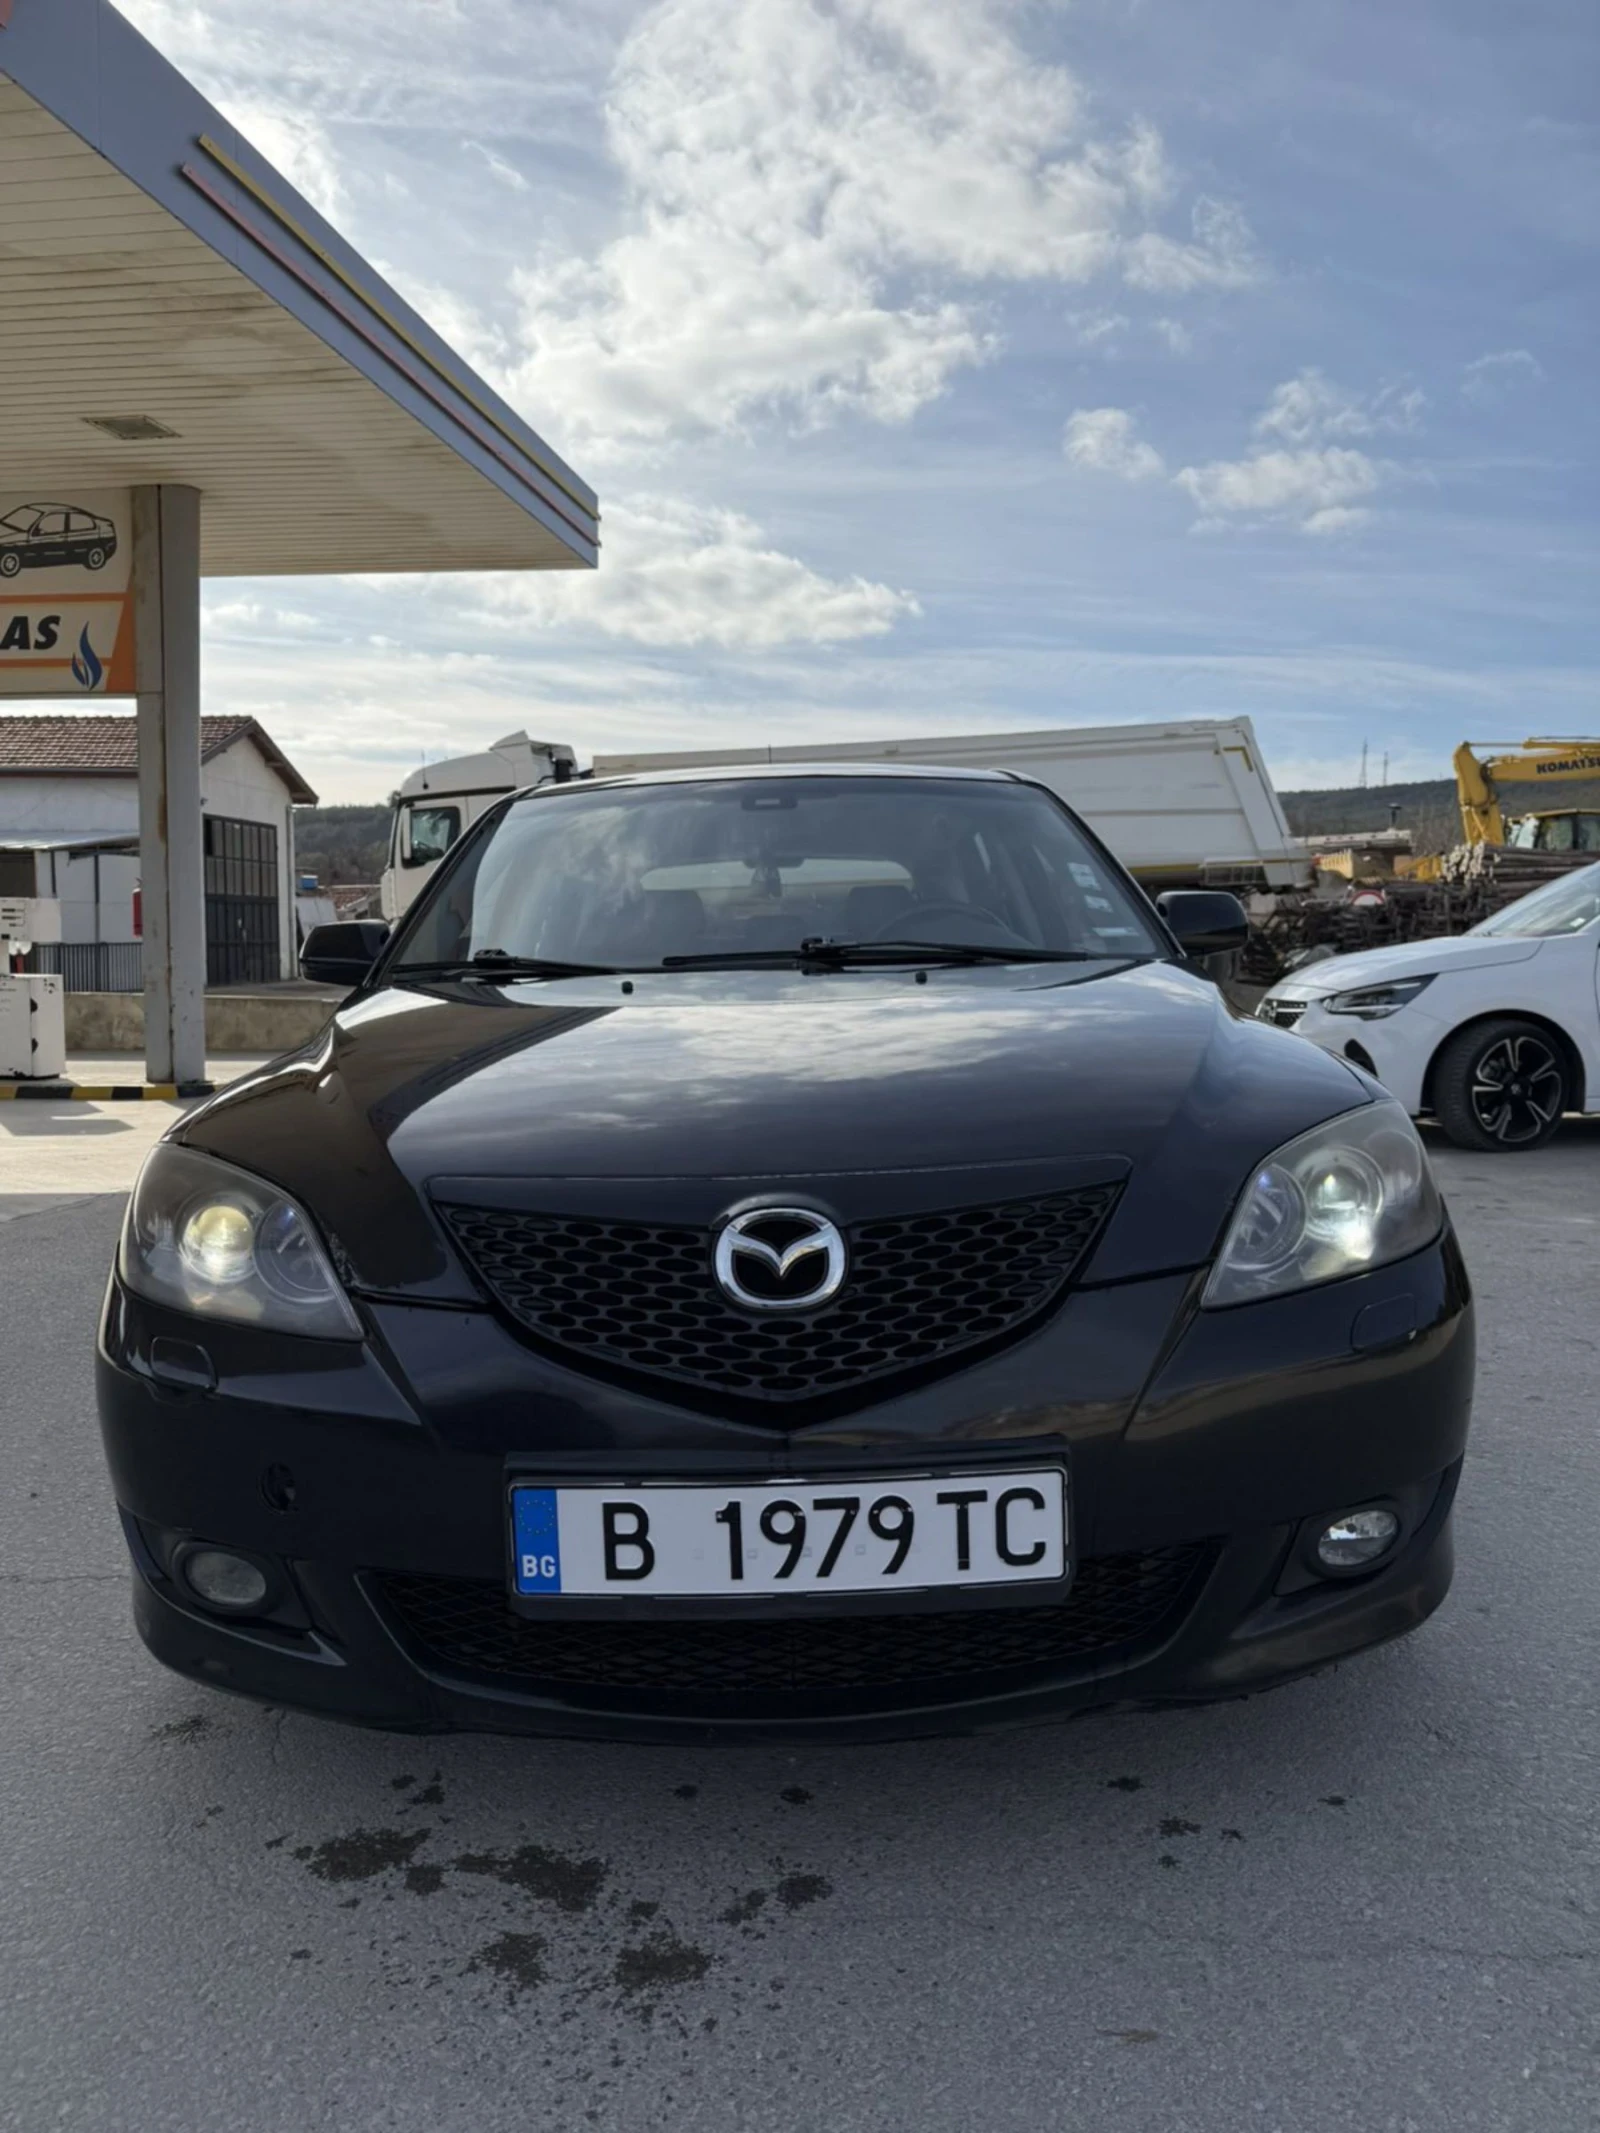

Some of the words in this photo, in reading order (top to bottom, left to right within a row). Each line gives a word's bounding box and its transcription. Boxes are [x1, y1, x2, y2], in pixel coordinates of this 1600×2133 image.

[602, 1502, 655, 1580] B
[715, 1495, 915, 1580] 1979
[937, 1488, 1046, 1571] TC
[522, 1555, 556, 1578] BG
